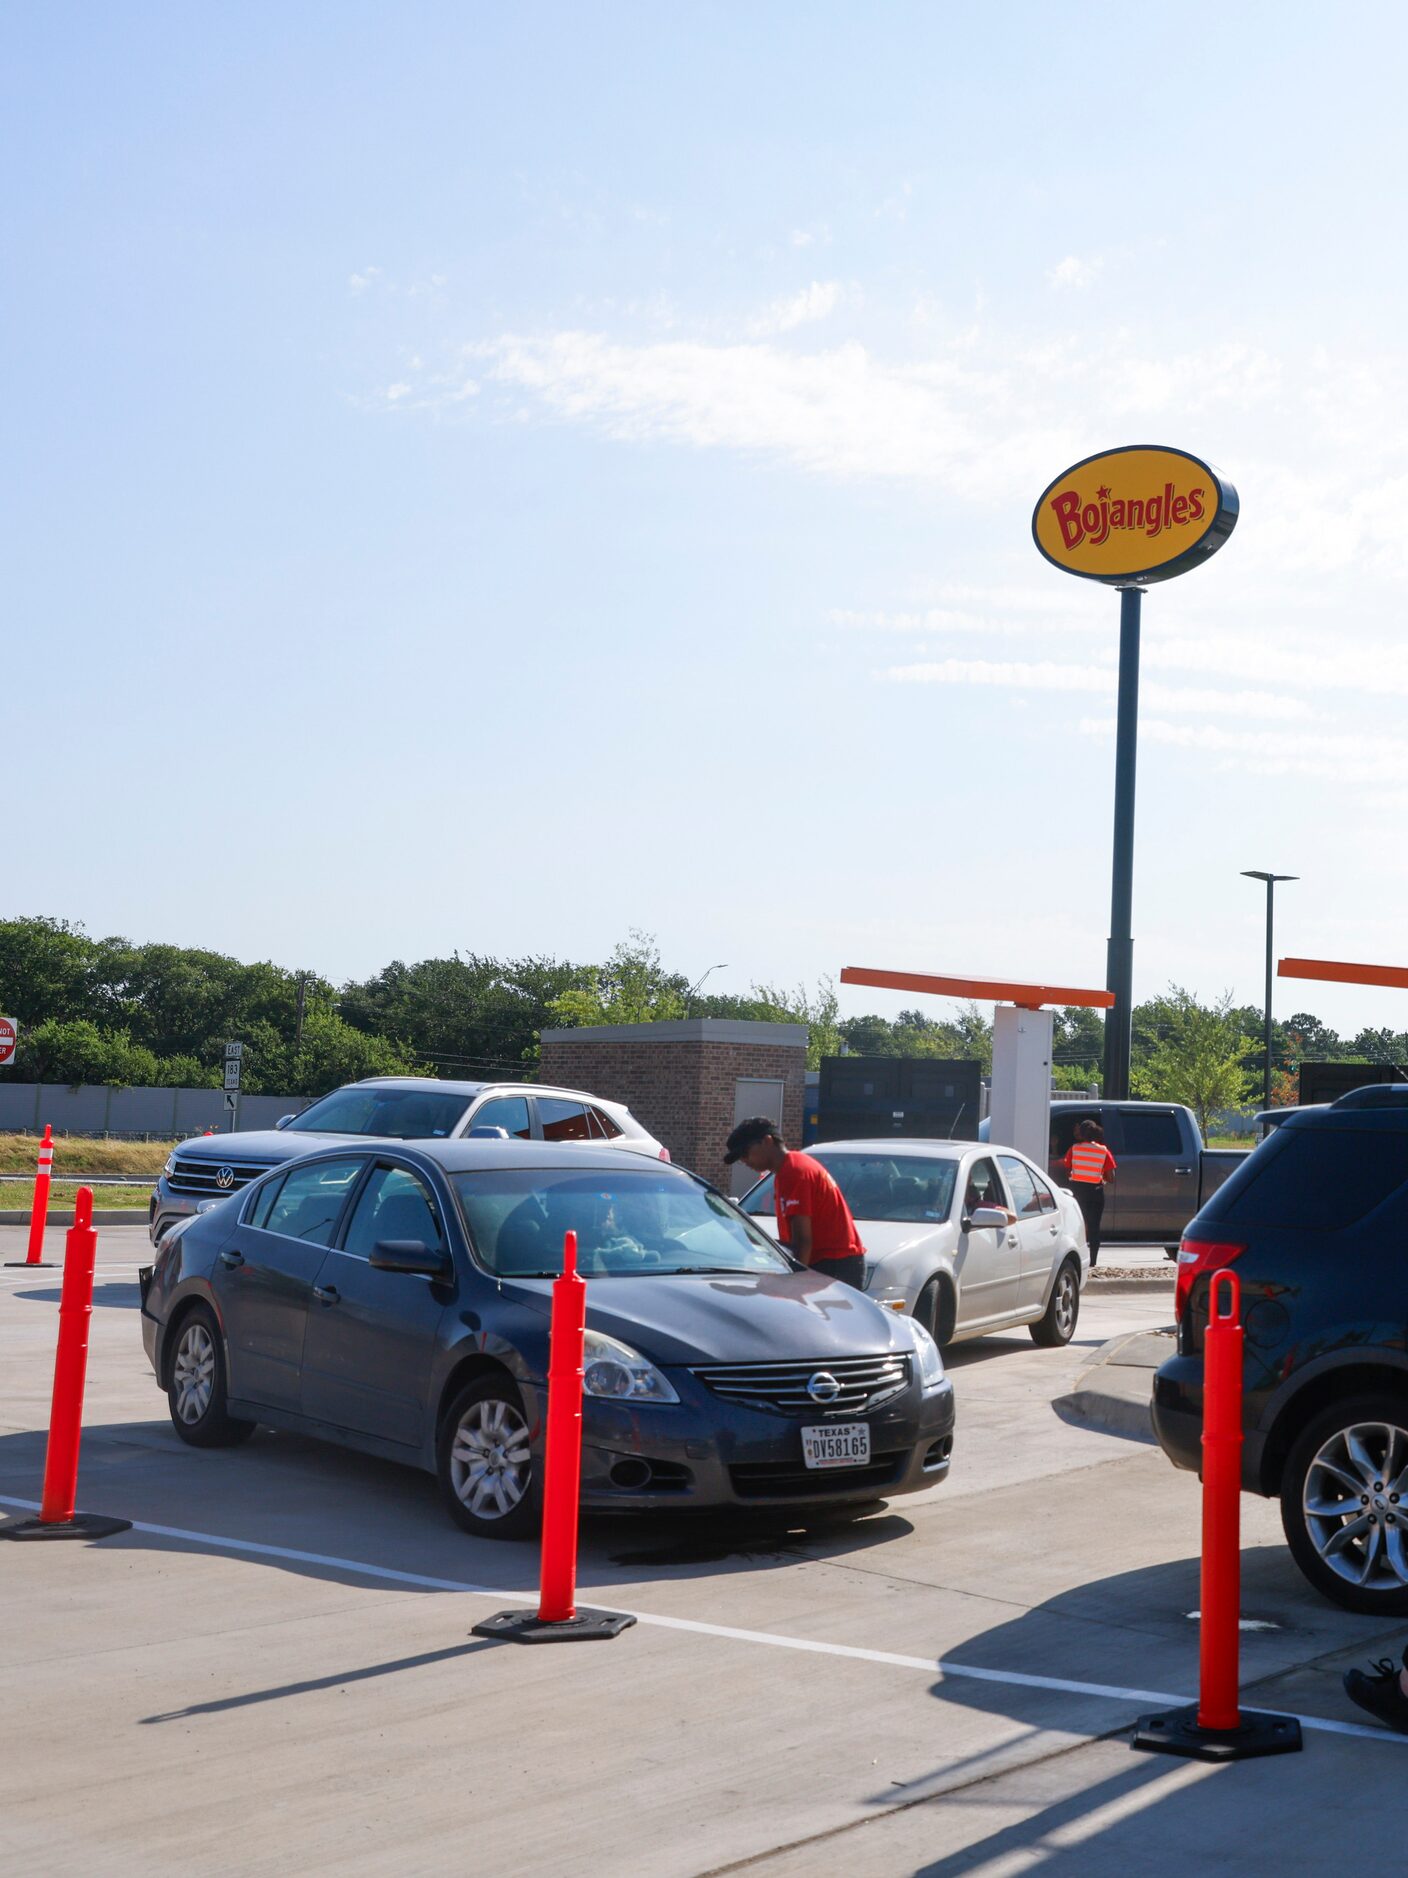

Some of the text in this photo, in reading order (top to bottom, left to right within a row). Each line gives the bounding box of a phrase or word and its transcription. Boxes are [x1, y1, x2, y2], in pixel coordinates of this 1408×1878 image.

[1050, 482, 1205, 551] Bojangles
[228, 1045, 240, 1055] EAST
[227, 1064, 238, 1075] 183
[818, 1428, 850, 1437] TEXAS
[813, 1437, 867, 1458] DV58165
